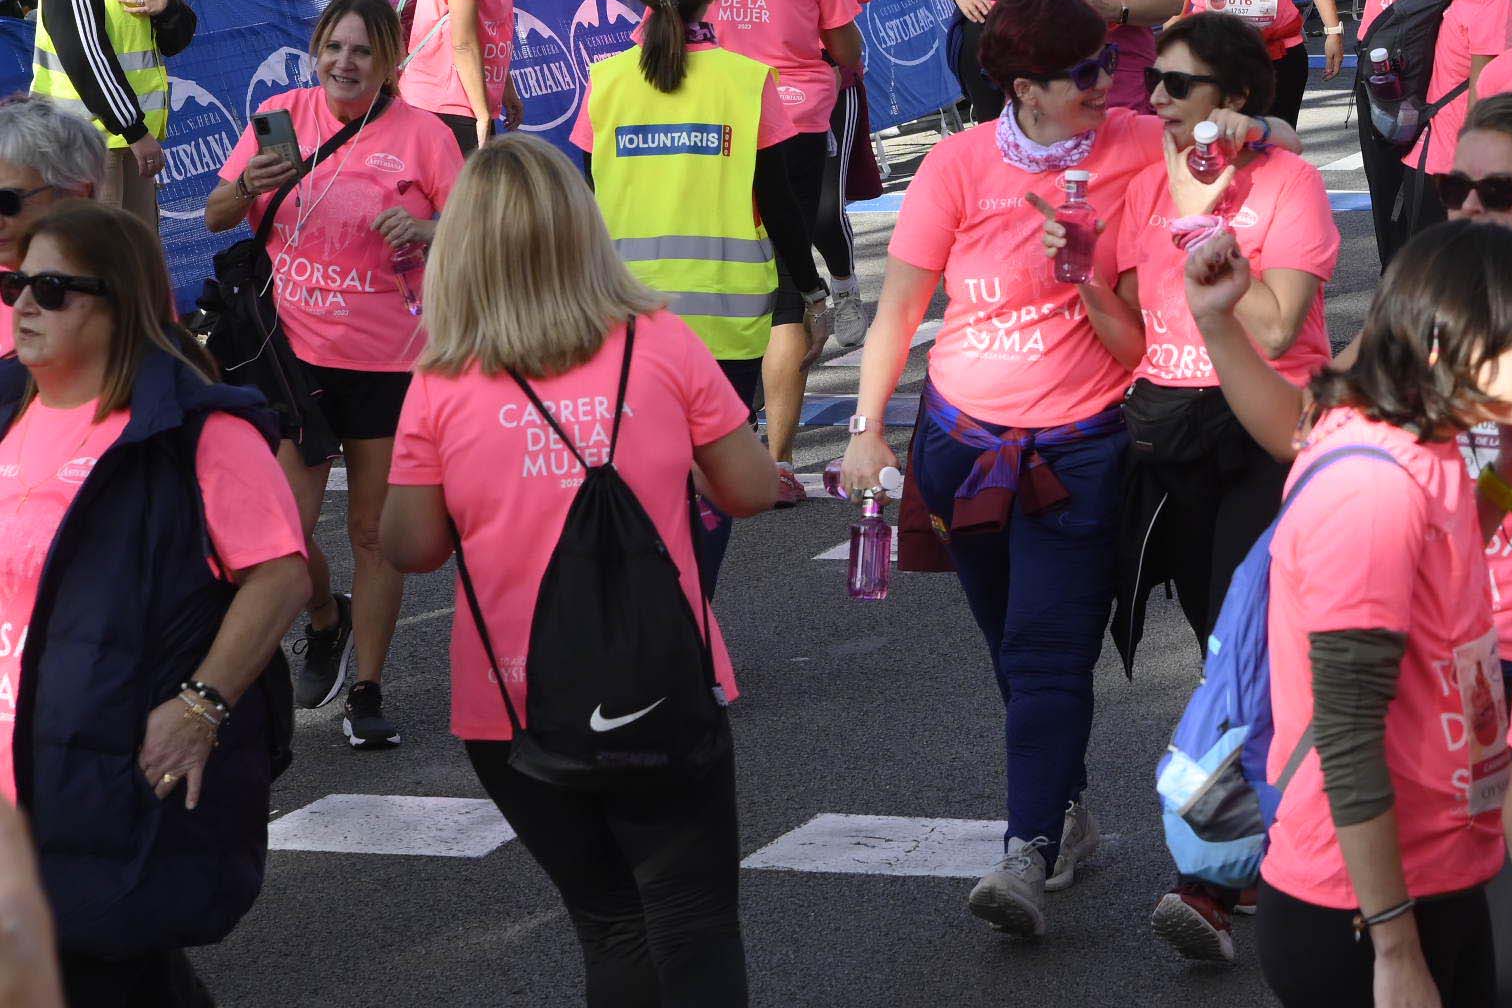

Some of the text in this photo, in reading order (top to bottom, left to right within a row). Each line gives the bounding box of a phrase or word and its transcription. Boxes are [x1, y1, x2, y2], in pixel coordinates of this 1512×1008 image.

[718, 9, 771, 23] MUJER
[587, 33, 617, 48] CENTRAL
[618, 131, 720, 150] VOLUNTARIS
[274, 253, 376, 293] DORSAL
[964, 277, 1002, 304] TU
[527, 423, 610, 452] DE LA
